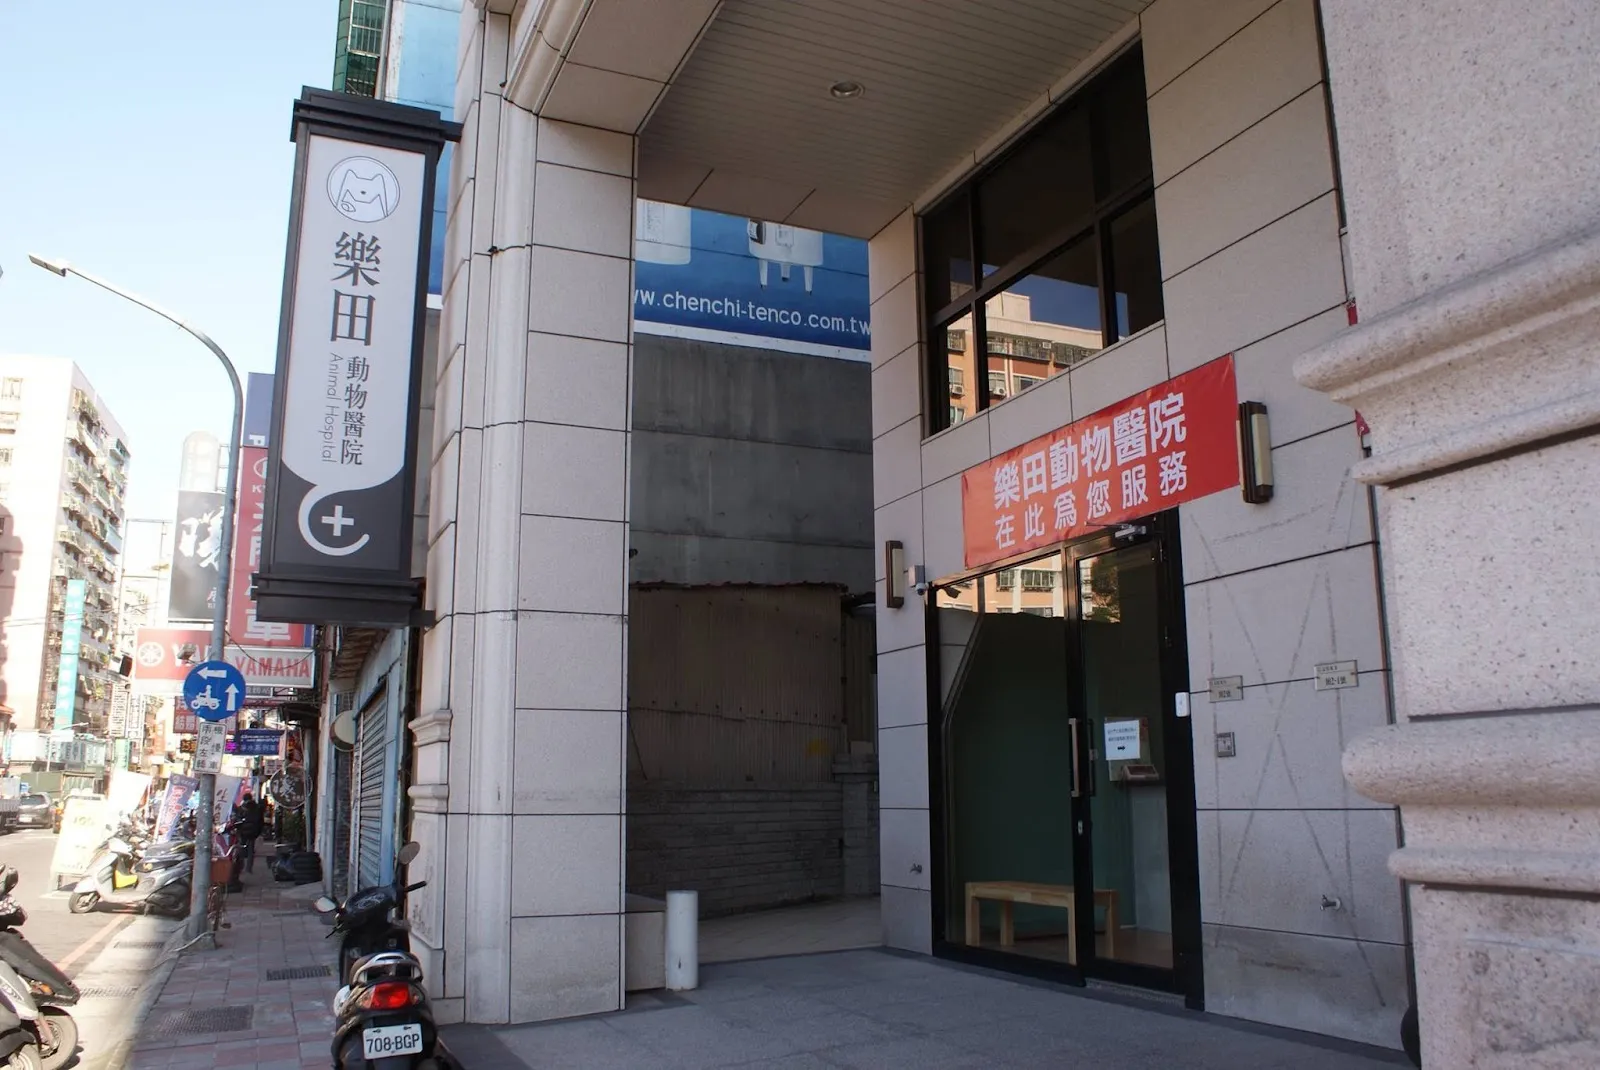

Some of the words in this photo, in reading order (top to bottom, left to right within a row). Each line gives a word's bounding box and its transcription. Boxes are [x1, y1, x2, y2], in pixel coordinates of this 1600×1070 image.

[330, 231, 382, 347] 樂田
[326, 352, 344, 400] Animal
[318, 405, 342, 463] Hospital
[340, 356, 370, 466] 動物醫院
[993, 391, 1187, 510] 樂田動物醫院
[235, 655, 311, 678] YAMAHA
[366, 1033, 420, 1053] 708-BGP
